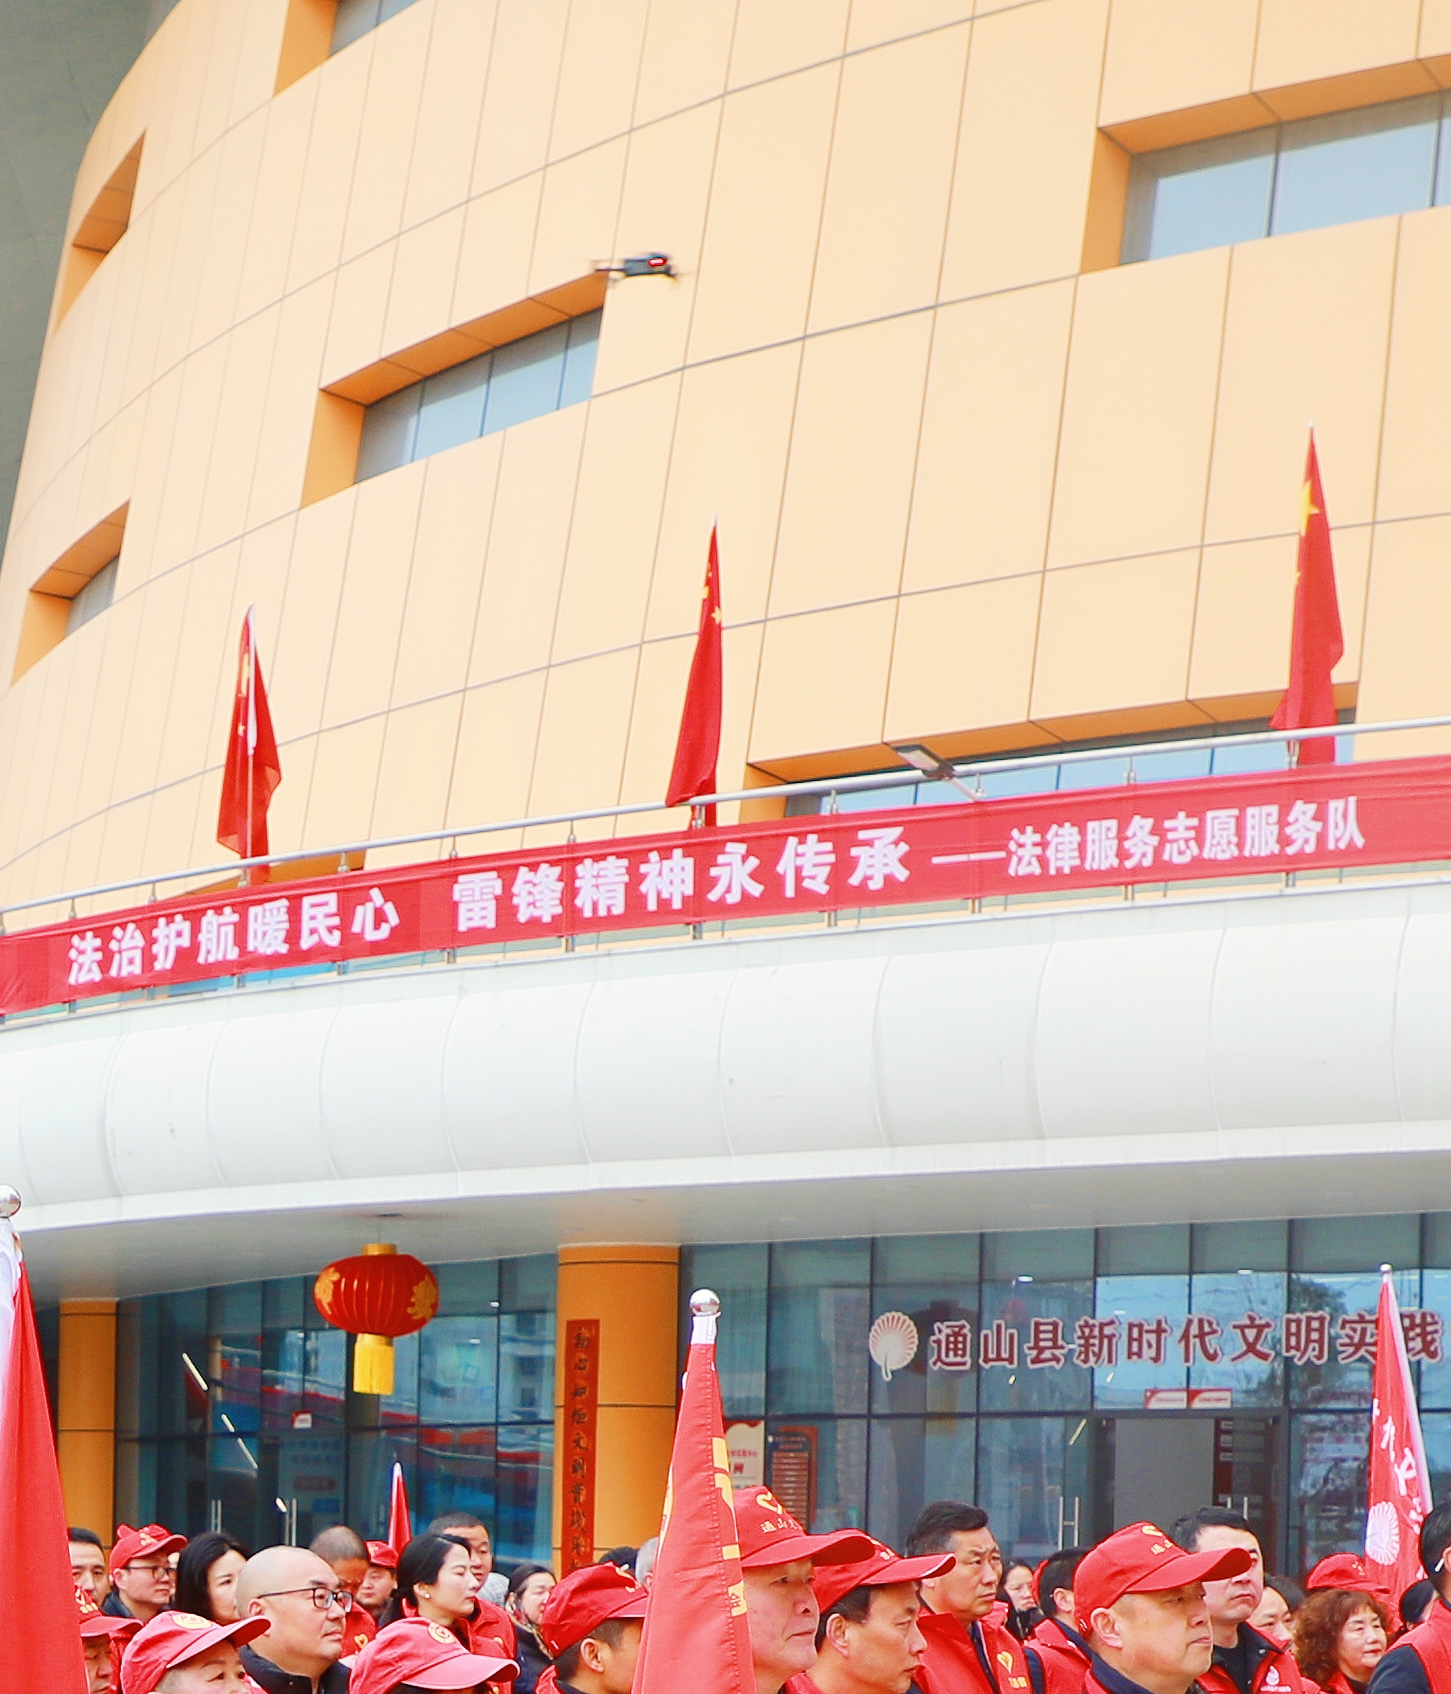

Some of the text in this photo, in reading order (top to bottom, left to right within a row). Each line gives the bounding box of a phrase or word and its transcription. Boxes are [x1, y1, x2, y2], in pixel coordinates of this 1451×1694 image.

[65, 888, 399, 987] 法治护航暖民心
[451, 827, 911, 934] 雷锋精神永传承
